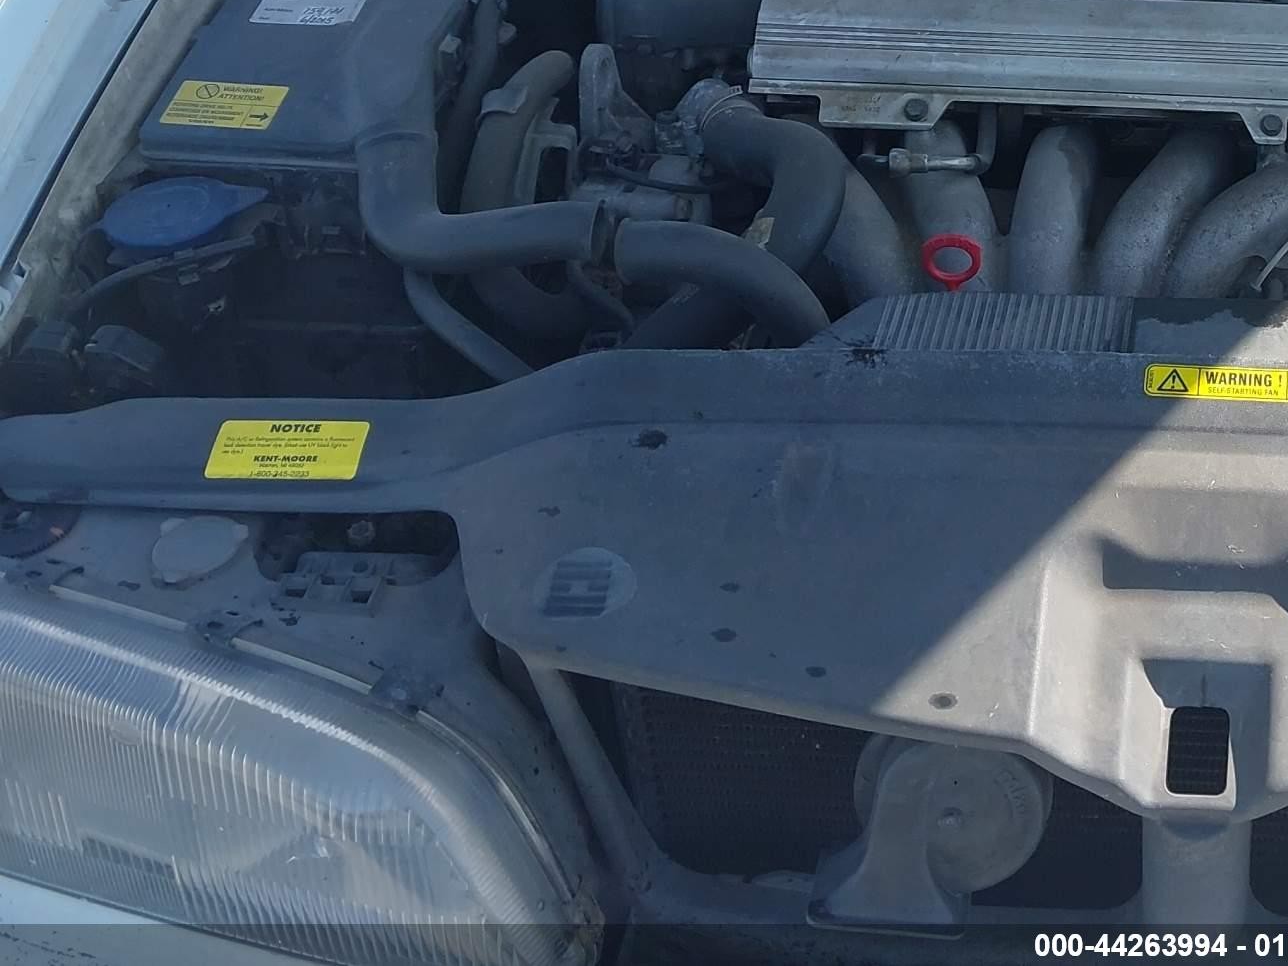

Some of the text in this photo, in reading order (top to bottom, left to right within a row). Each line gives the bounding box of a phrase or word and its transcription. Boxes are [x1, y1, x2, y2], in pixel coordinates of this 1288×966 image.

[1206, 371, 1272, 387] WARNING
[1265, 389, 1279, 397] FAN
[270, 424, 322, 433] NOTICE
